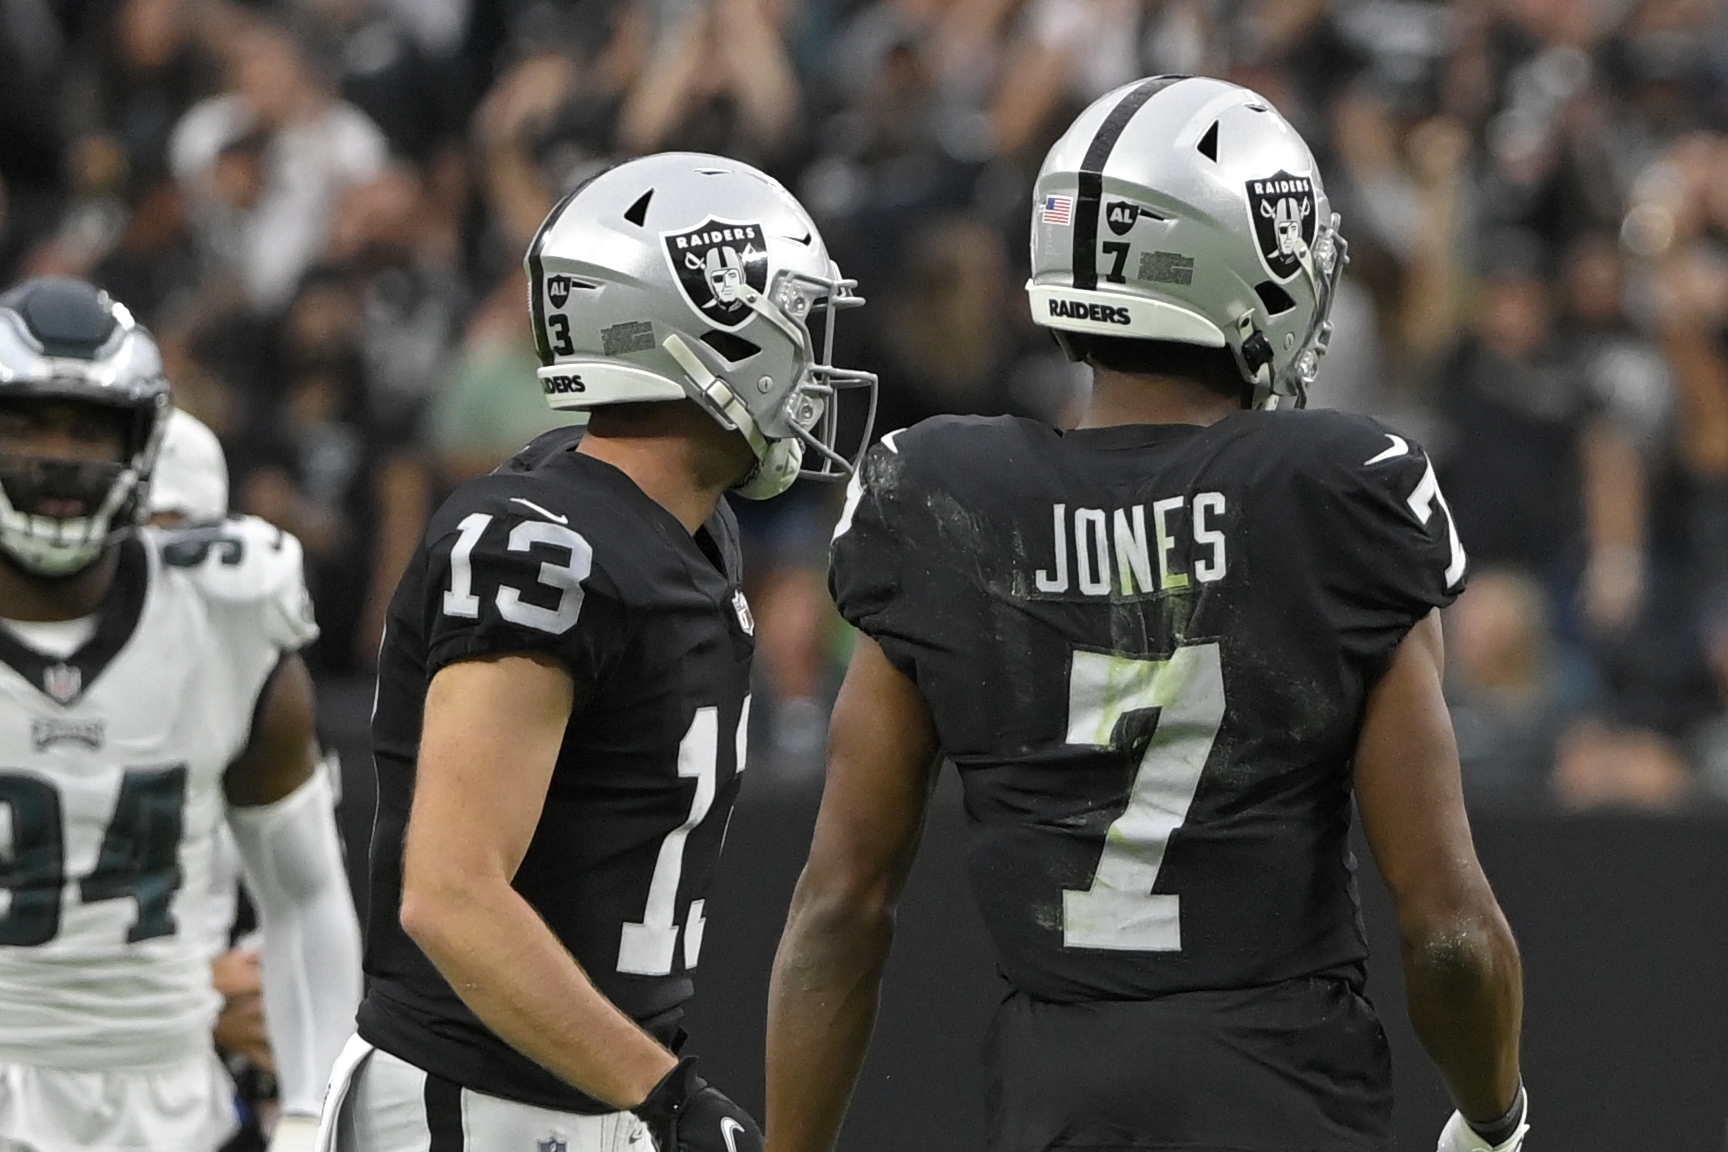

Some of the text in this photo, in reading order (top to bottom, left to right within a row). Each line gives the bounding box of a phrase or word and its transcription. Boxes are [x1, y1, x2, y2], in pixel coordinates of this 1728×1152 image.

[1254, 179, 1309, 195] RAIDERS
[1109, 207, 1133, 224] AL
[675, 226, 755, 249] RAIDERS
[1102, 241, 1131, 284] 7
[550, 281, 568, 296] AL
[1048, 298, 1131, 325] RAIDERS
[548, 313, 575, 356] 3
[541, 374, 586, 394] DERS
[1035, 491, 1227, 596] JONES
[443, 512, 593, 635] 13
[1062, 641, 1227, 952] 7
[616, 692, 752, 977] 1
